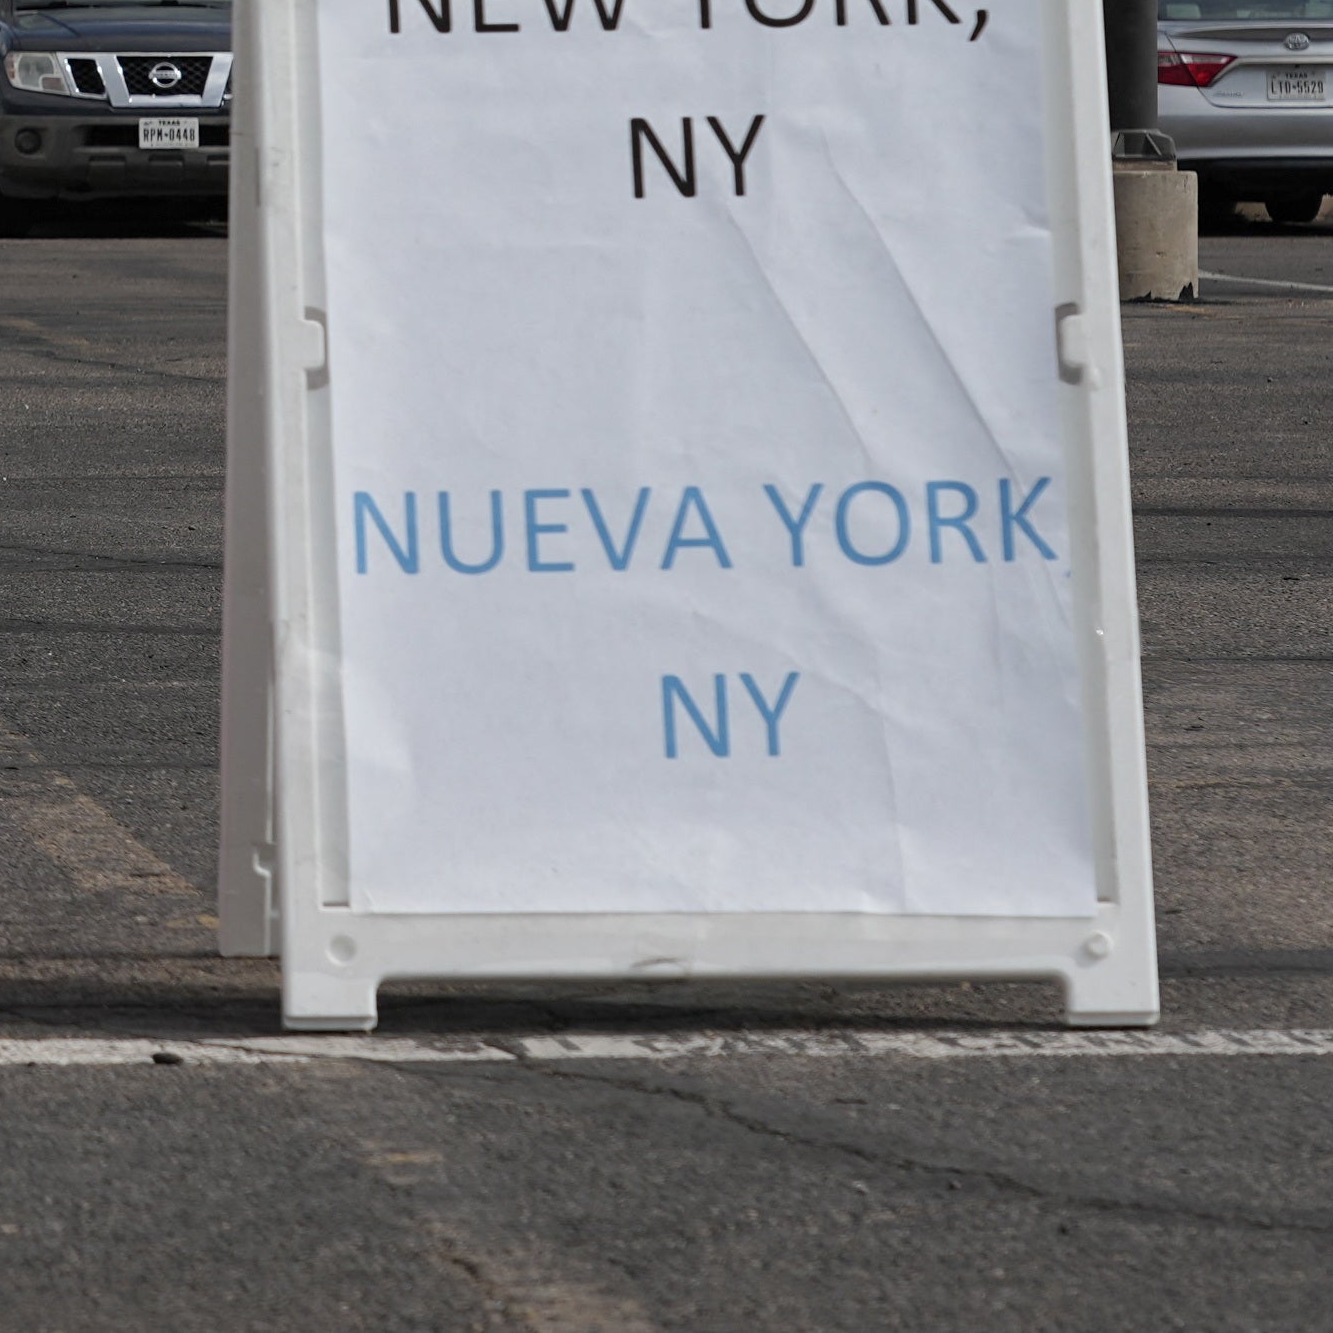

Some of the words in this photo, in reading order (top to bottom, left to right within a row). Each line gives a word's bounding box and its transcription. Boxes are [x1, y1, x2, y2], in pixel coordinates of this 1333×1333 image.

[630, 114, 766, 199] NY
[353, 486, 733, 575] NUEVA
[762, 476, 1071, 579] YORK
[660, 672, 801, 759] NY
